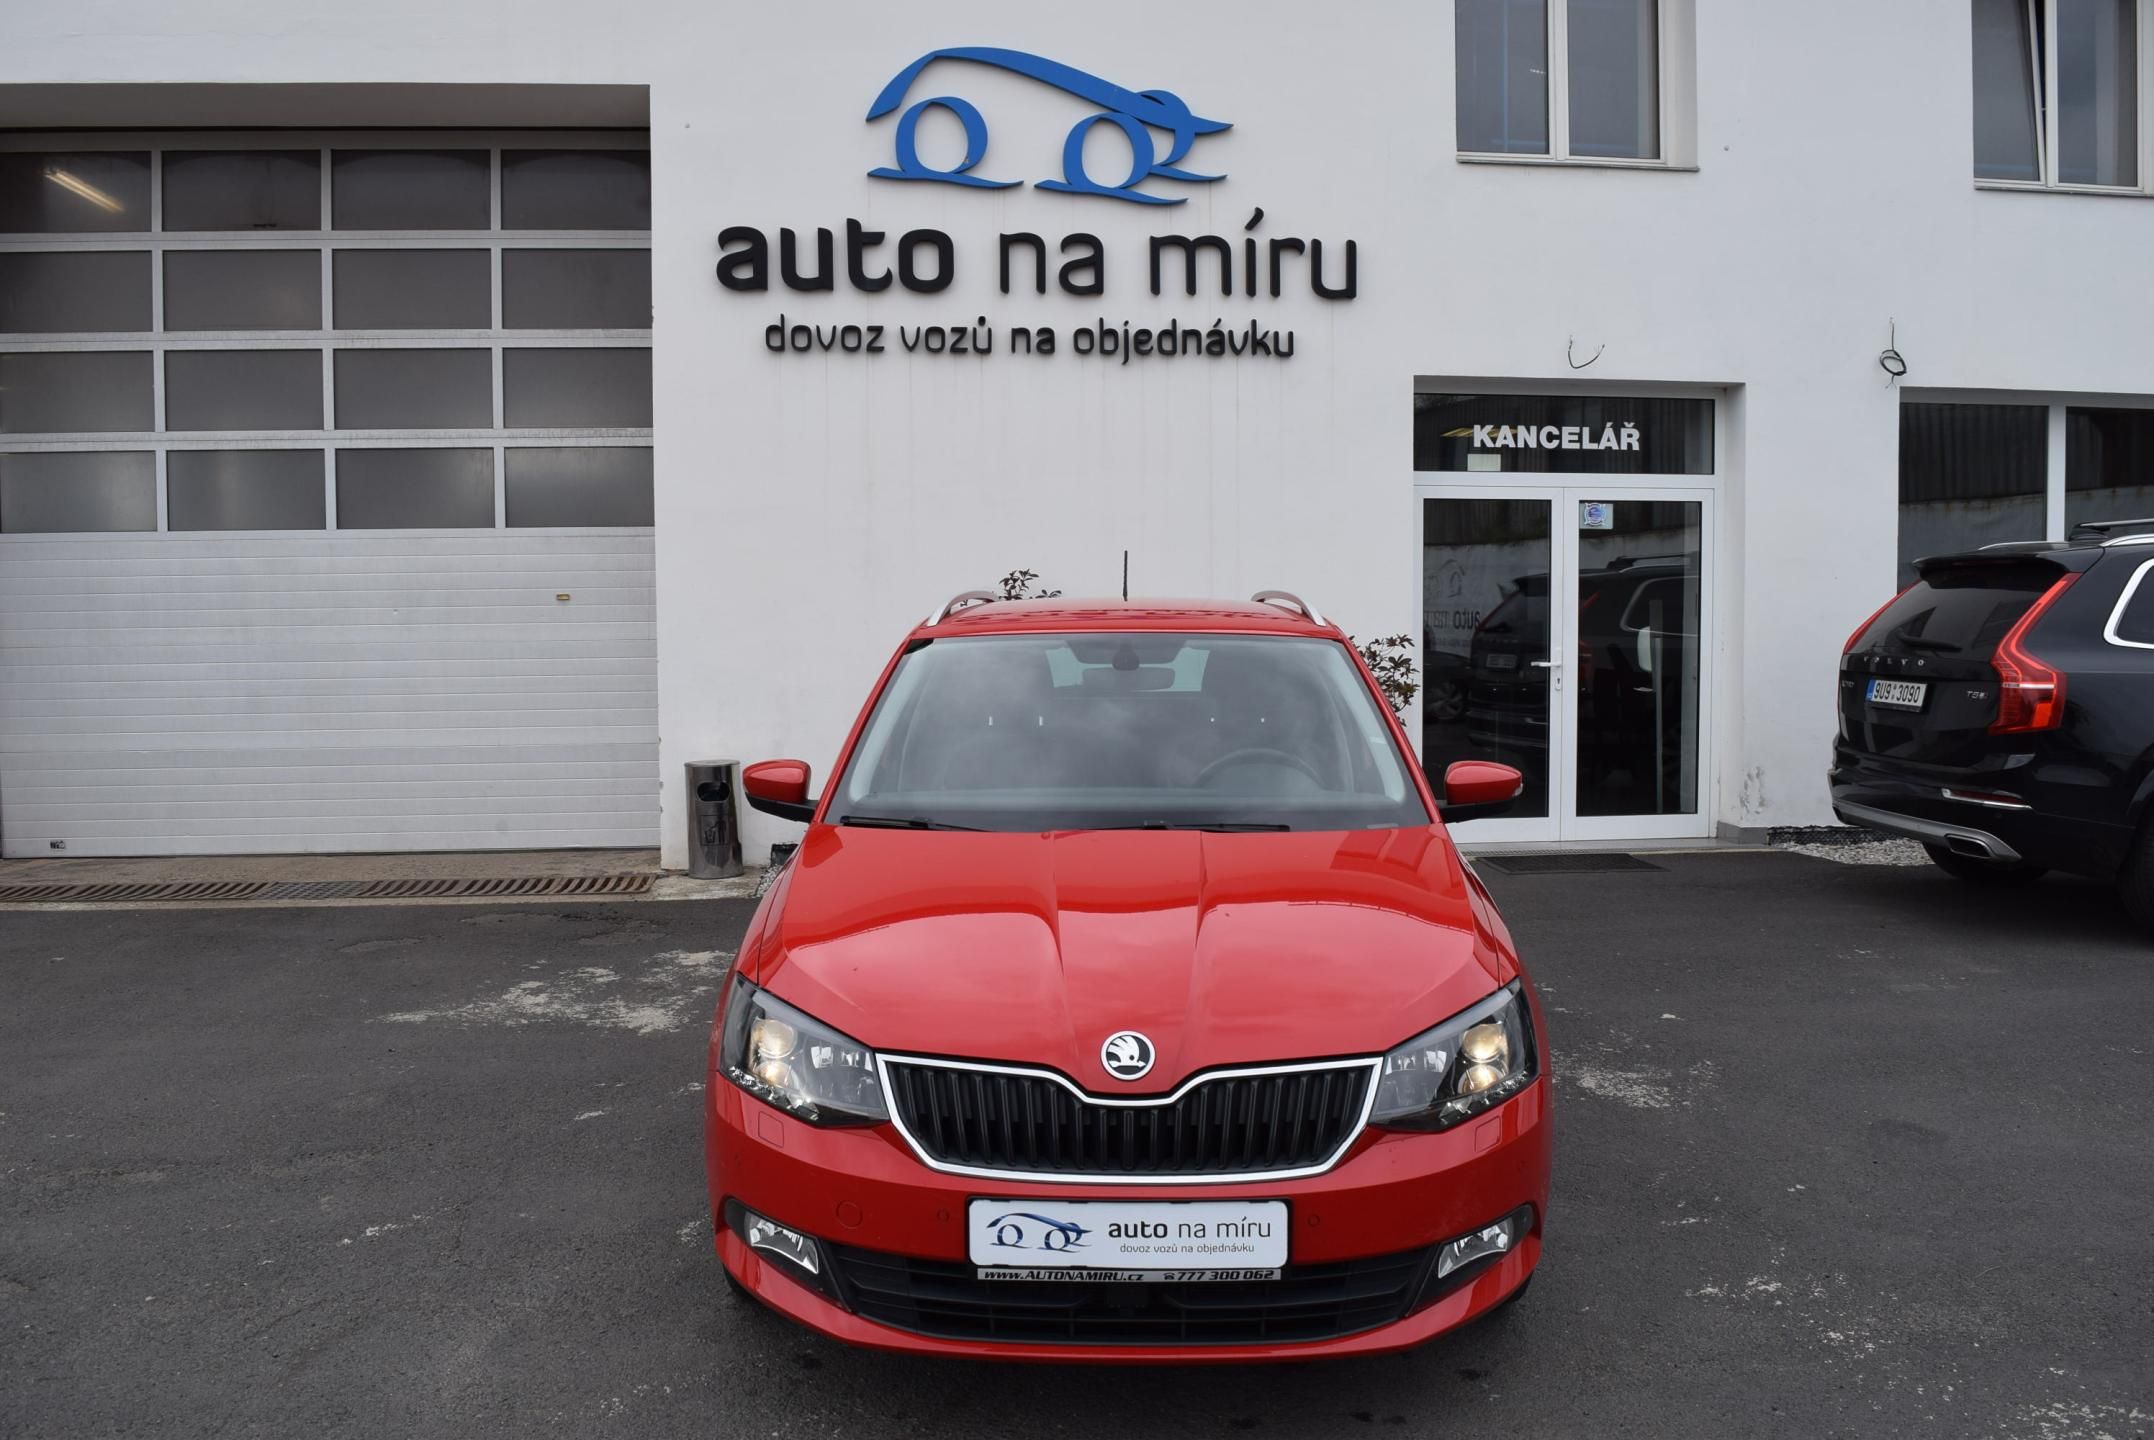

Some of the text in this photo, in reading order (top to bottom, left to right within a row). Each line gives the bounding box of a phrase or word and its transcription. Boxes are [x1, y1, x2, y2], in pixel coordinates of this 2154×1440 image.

[716, 206, 1358, 299] auto na míru
[765, 313, 1295, 365] dovoz vozů na objednávku
[1473, 421, 1641, 451] KANCELÁŘ
[1863, 655, 1925, 667] VOLVO
[1873, 682, 1892, 700] 9U9
[1896, 684, 1921, 704] 3090
[1108, 1216, 1271, 1239] auto na míru
[1119, 1242, 1255, 1255] dovoz vozů na objednávku
[1208, 1271, 1240, 1281] 300
[1243, 1270, 1274, 1280] 062
